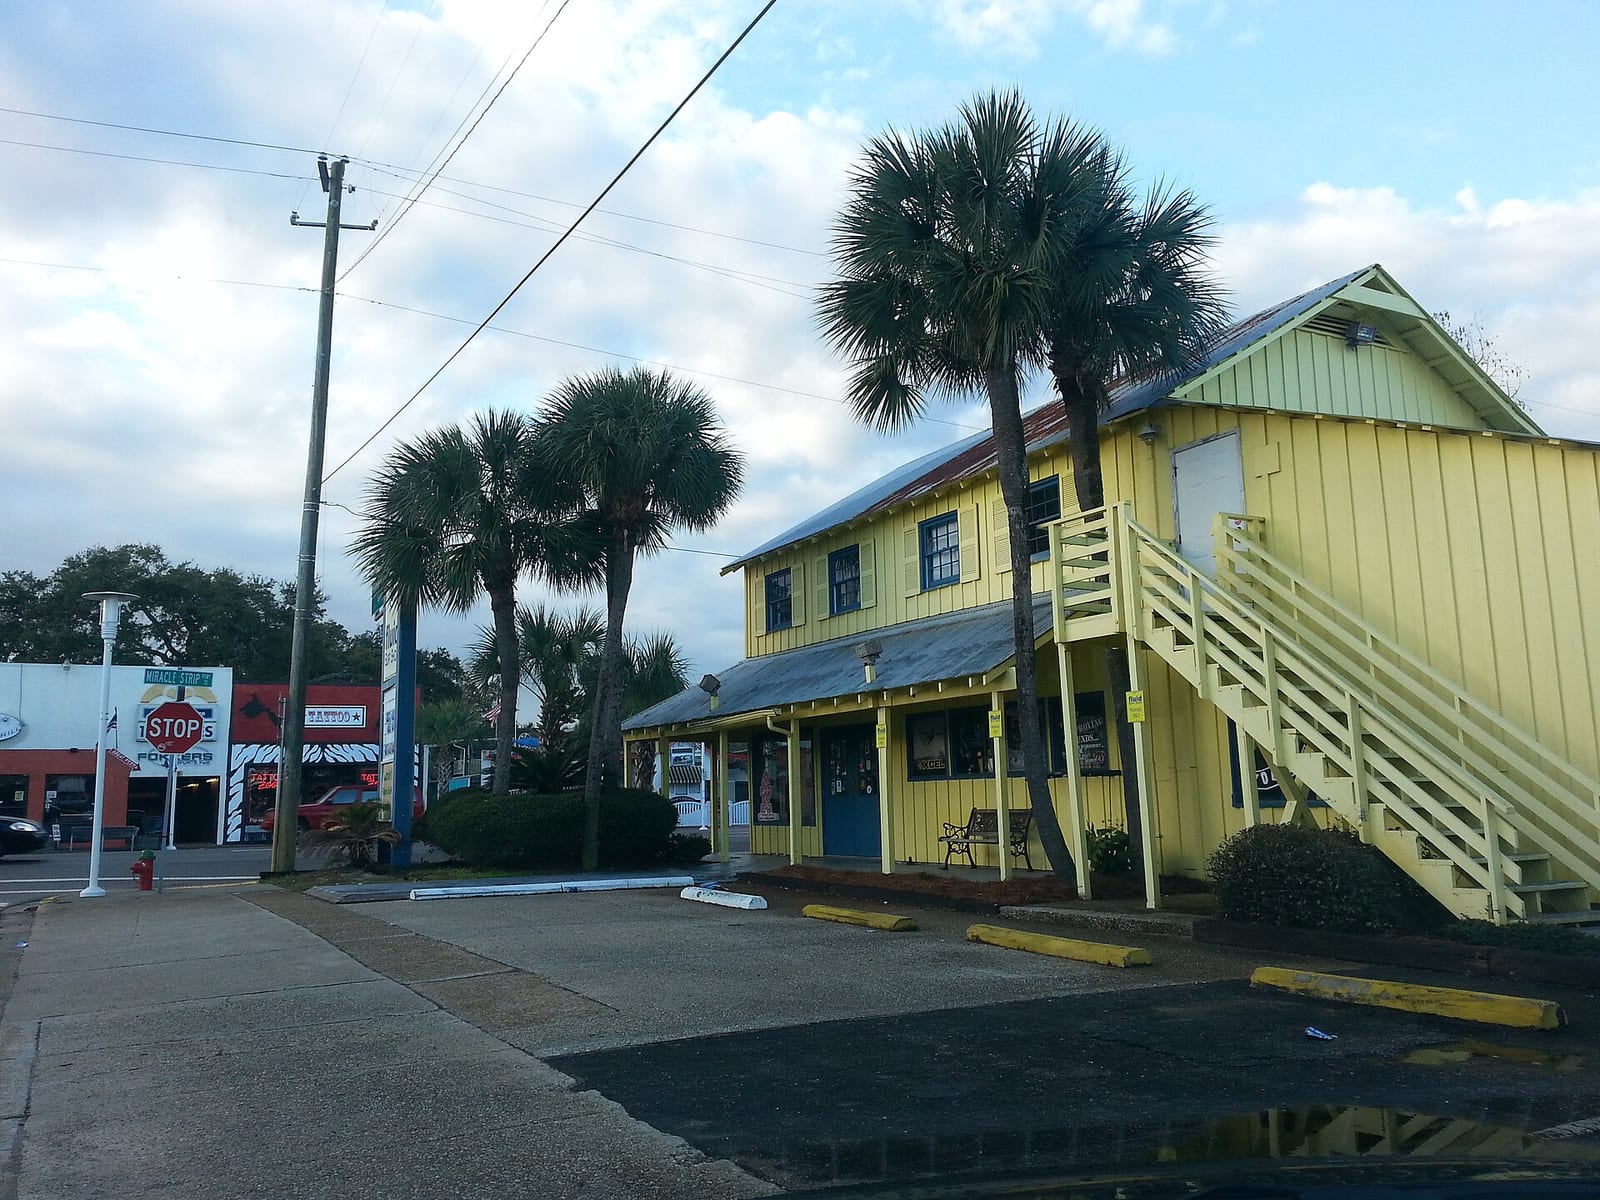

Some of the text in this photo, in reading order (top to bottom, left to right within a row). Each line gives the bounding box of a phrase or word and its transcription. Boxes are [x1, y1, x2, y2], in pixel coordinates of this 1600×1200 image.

[146, 670, 177, 684] MIRACLE
[180, 672, 200, 685] STRIP
[308, 710, 351, 723] TATTOO
[149, 717, 200, 738] STOP
[137, 752, 213, 761] FOKERS
